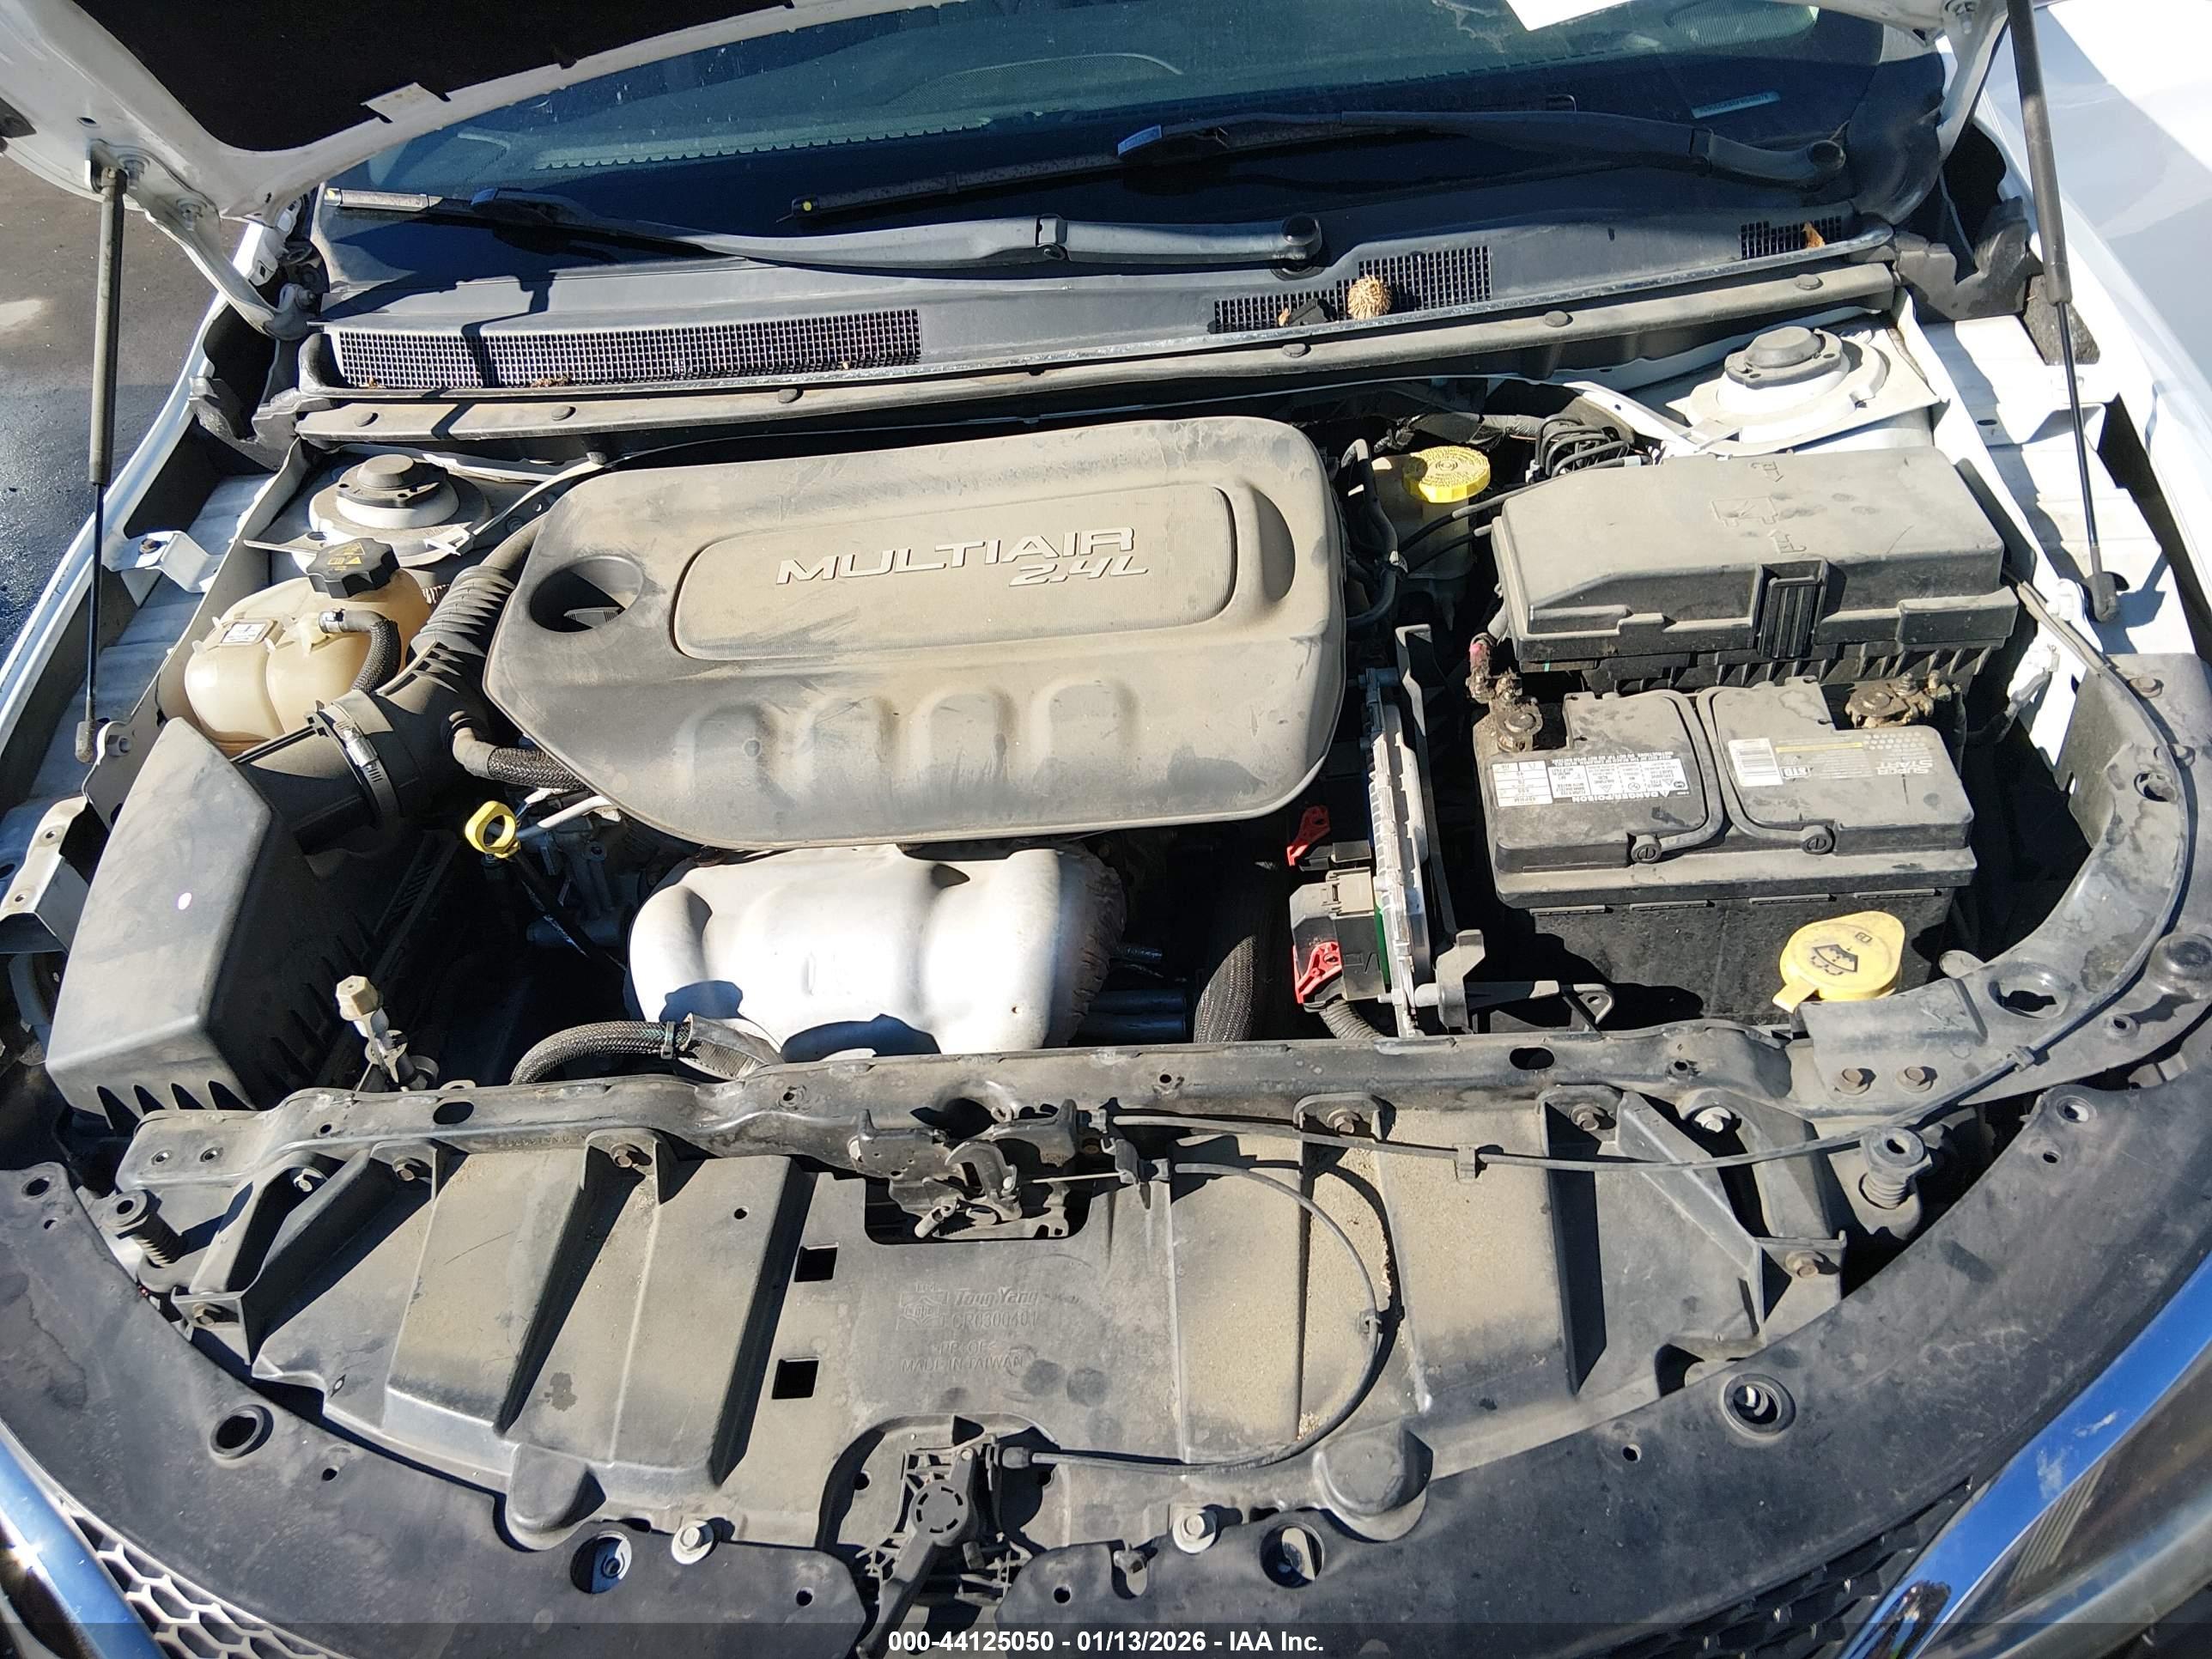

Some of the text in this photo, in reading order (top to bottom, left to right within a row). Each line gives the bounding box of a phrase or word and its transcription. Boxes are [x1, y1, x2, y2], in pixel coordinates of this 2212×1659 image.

[776, 526, 1134, 585] MULTIAIR
[1009, 555, 1149, 587] 2.4L
[954, 1286, 1039, 1307] Tong Yang
[949, 1356, 963, 1371] IN
[968, 1355, 1024, 1370] TAIWAN
